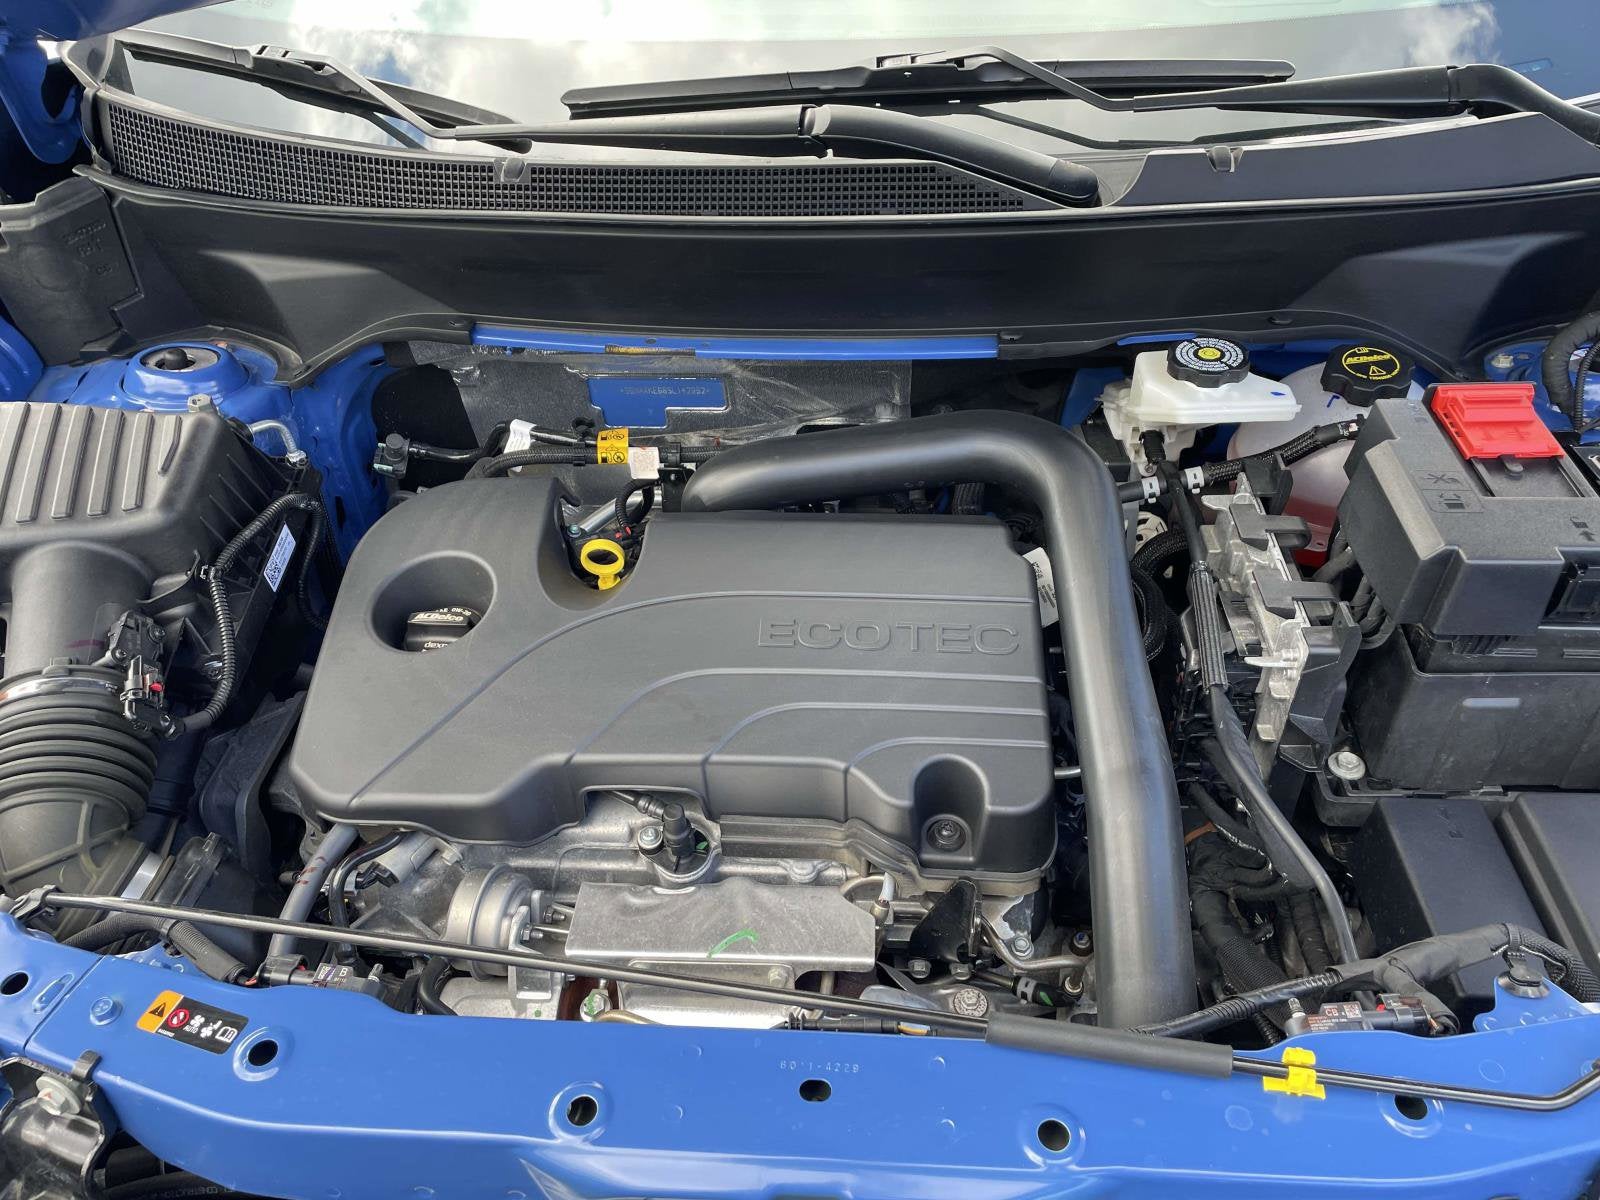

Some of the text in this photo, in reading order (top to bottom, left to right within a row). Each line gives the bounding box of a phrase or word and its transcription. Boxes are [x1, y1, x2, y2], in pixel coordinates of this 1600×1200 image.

[412, 612, 464, 622] ACDelco
[758, 618, 1019, 656] ECOTEC
[182, 1024, 199, 1034] AUTO
